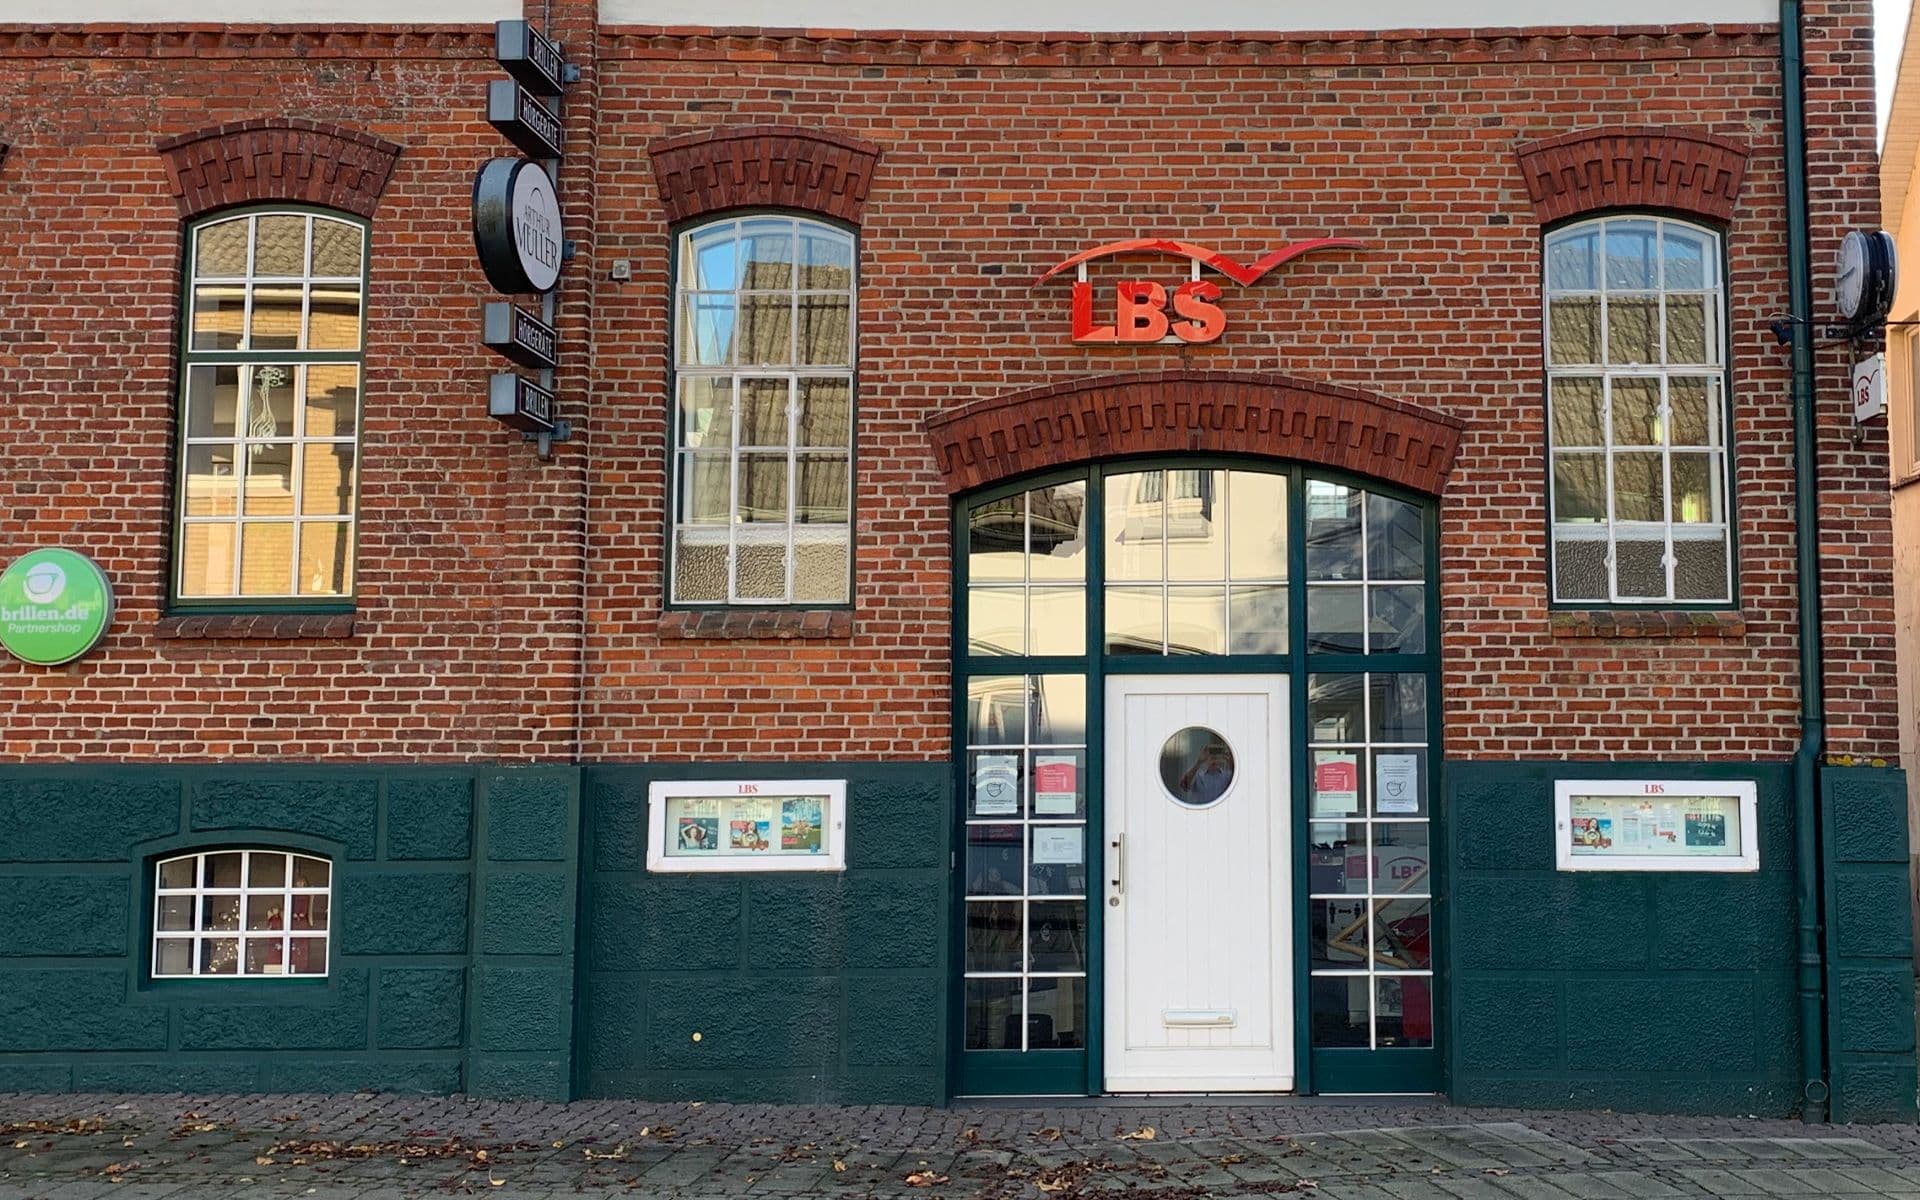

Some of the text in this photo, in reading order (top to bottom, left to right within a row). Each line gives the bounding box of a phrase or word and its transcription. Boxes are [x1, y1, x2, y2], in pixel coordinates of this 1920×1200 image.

[533, 36, 559, 81] BRILLEN
[523, 98, 558, 147] HÖRGERÄTE
[524, 203, 551, 238] ARTHUR
[516, 216, 558, 273] MÜLLER
[1071, 281, 1226, 344] LBS
[518, 318, 553, 358] HÖRGERÄTE
[525, 386, 550, 421] BRILLEN
[1857, 386, 1869, 406] LBS
[1, 605, 89, 621] brillen.de
[8, 623, 81, 634] Partnershop
[738, 784, 759, 794] LBS
[1645, 784, 1665, 794] LBS
